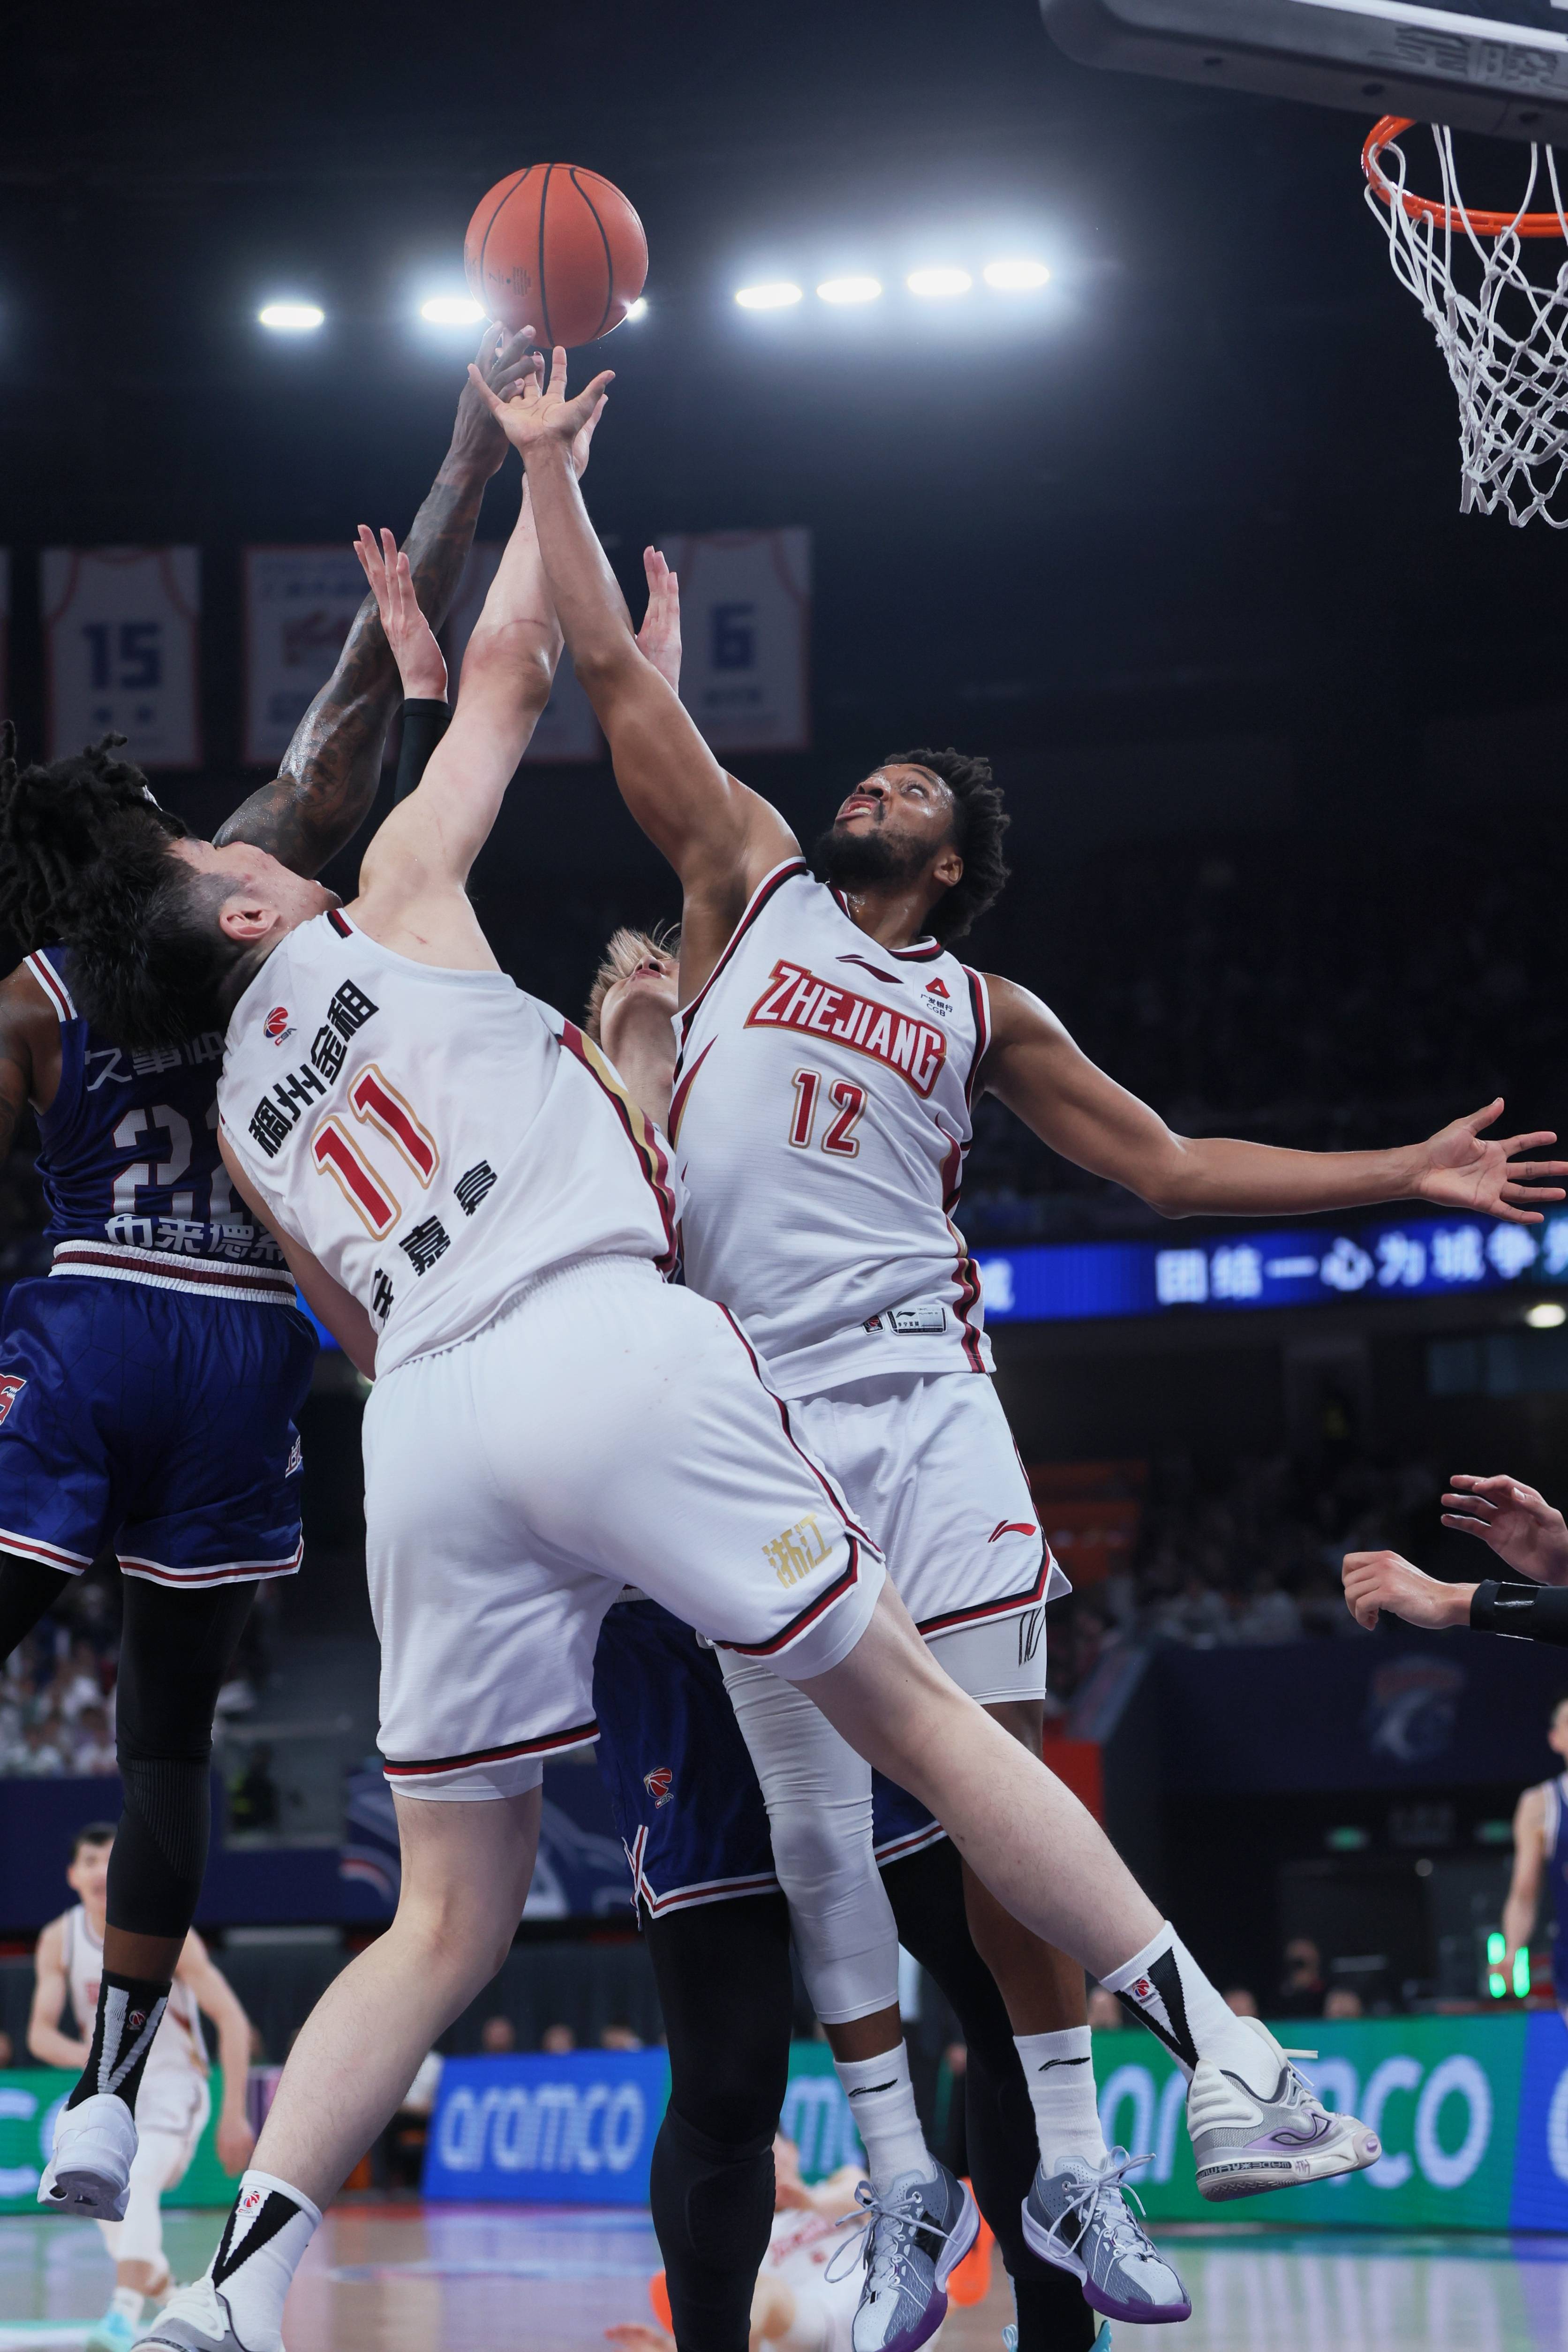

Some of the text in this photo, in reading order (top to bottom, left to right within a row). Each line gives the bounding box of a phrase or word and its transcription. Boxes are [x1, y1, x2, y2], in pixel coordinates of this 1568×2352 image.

[83, 623, 163, 689] 15
[709, 603, 754, 669] 6
[753, 965, 942, 1093] ZHEJIANG
[927, 1003, 945, 1017] CGB
[248, 979, 379, 1158] 稠州金租
[789, 1068, 867, 1158] 12
[311, 1063, 440, 1241] 11
[439, 2084, 647, 2174] aramco
